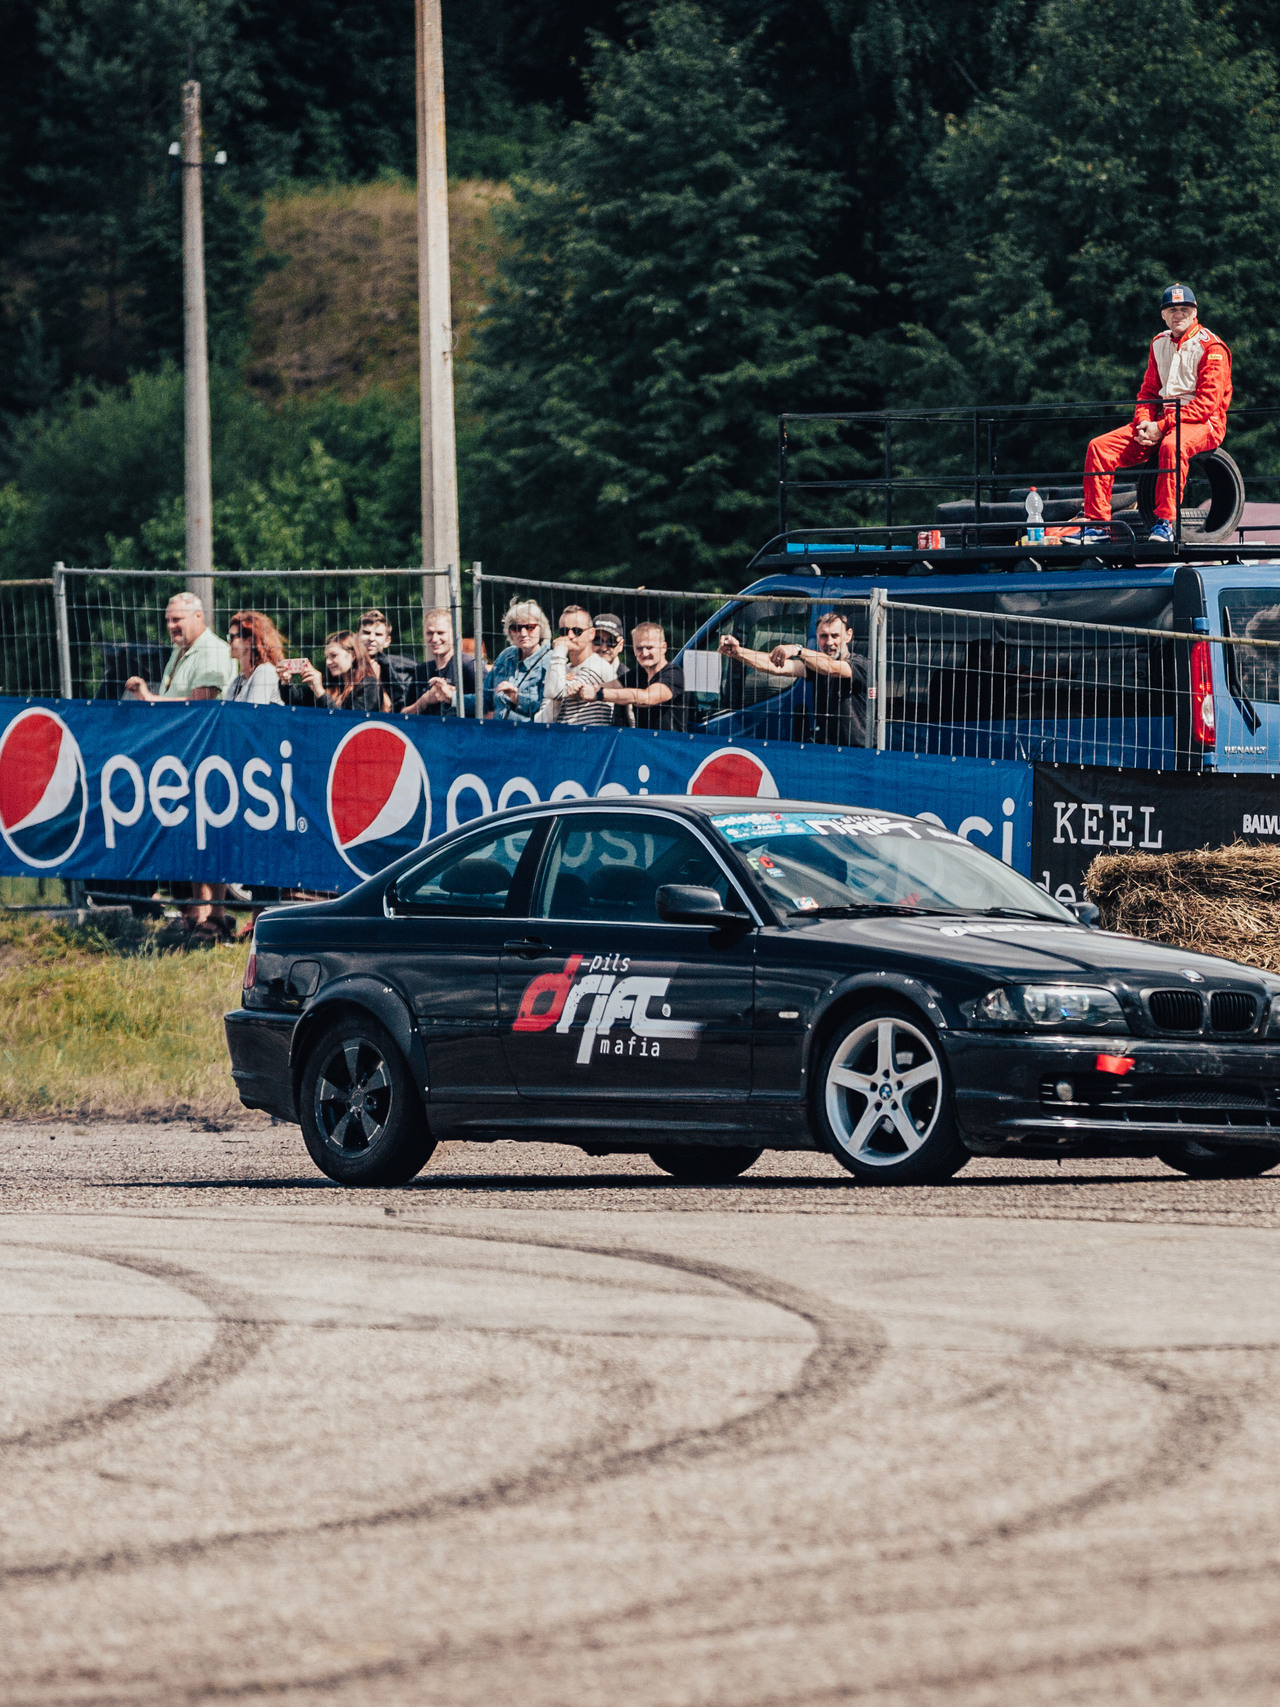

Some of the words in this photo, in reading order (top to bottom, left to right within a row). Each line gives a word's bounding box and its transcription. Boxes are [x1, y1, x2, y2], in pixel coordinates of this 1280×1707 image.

[1224, 745, 1268, 754] RENAULT
[101, 740, 297, 850] pepsi
[1052, 801, 1163, 849] KEEL
[600, 1026, 661, 1057] mafia
